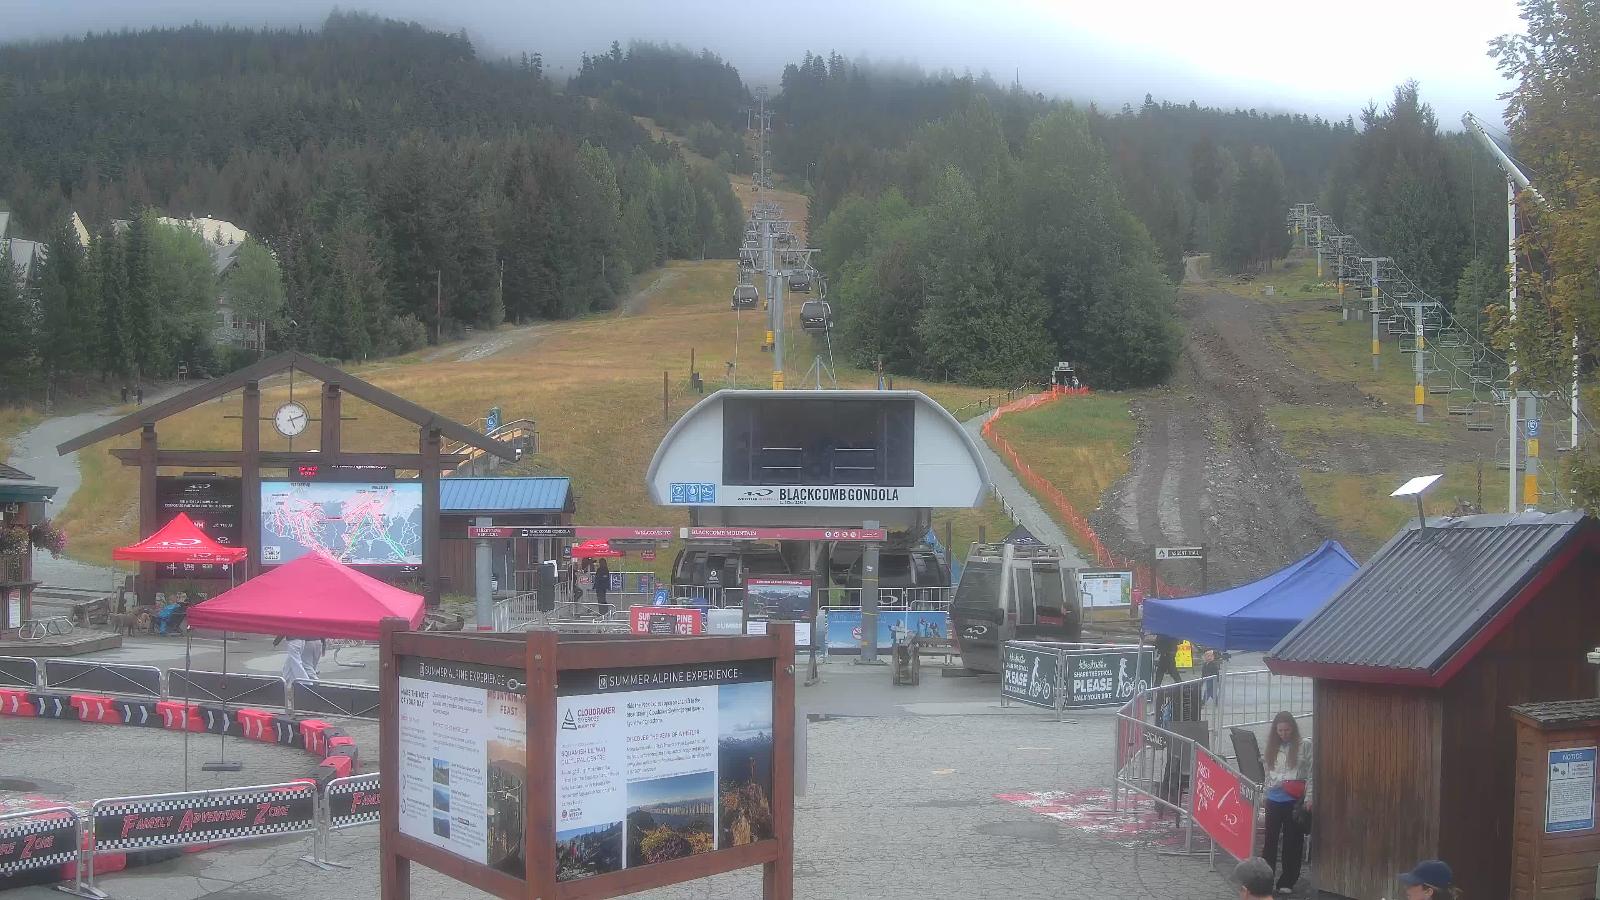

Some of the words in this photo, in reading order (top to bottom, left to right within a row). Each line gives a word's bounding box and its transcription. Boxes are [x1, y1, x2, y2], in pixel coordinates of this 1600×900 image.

[779, 488, 846, 501] BLACKCOMB
[848, 488, 899, 501] GONDOLA
[609, 673, 650, 687] SUMMER
[652, 671, 684, 684] ALPINE
[686, 668, 739, 681] EXPERIENCE
[1005, 670, 1028, 687] PLEASE
[1073, 678, 1113, 693] PLEASE
[1562, 752, 1583, 761] NOTICE
